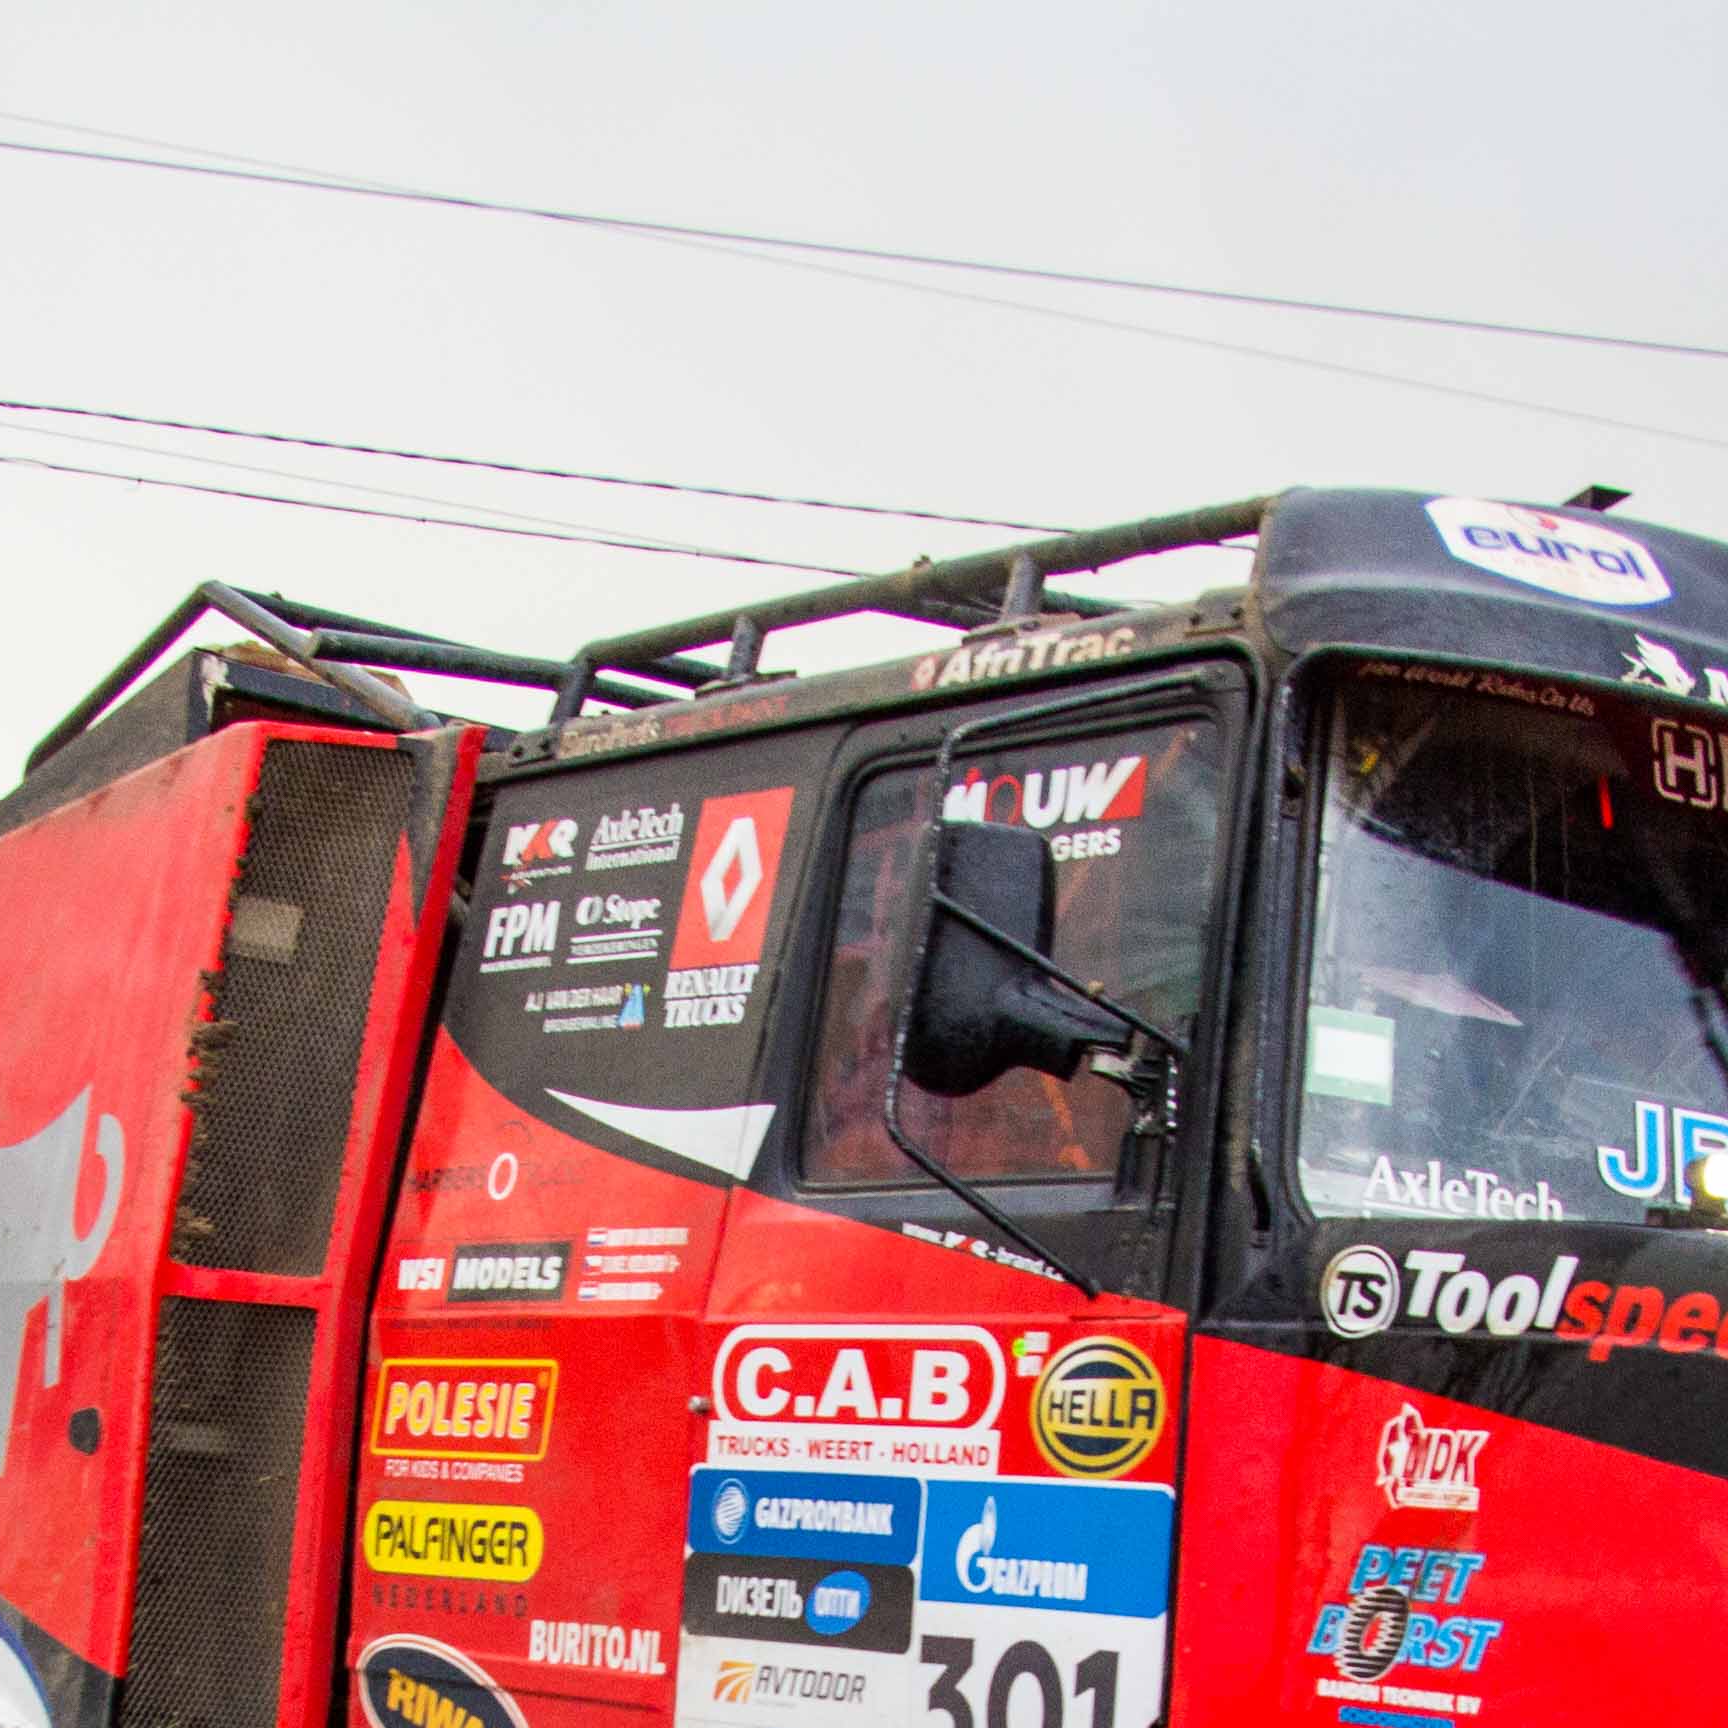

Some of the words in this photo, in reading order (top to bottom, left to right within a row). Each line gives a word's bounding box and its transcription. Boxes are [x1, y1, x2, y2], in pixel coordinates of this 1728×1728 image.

[1461, 526, 1646, 581] eurol
[1050, 827, 1121, 863] GERS
[483, 900, 561, 957] FPM
[664, 964, 760, 999] RENAULT
[664, 995, 747, 1028] TRUCKS
[1362, 1155, 1563, 1222] AxleTech
[398, 1258, 445, 1290] WSI
[453, 1256, 563, 1291] MODELS
[736, 1347, 970, 1421] C.A.B
[385, 1381, 536, 1438] POLESIE
[1048, 1387, 1156, 1431] HELLA
[385, 1459, 415, 1478] FOR
[451, 1461, 523, 1483] COMPANIES
[717, 1435, 790, 1458] TRUCKS
[808, 1438, 873, 1462] WEERT
[892, 1442, 990, 1467] HOLLAND
[754, 1497, 894, 1536] GAZPROMBANK
[375, 1513, 528, 1567] PALFINGER
[991, 1556, 1088, 1601] GAZPROM
[1348, 1543, 1485, 1604] PEET
[373, 1585, 528, 1617] NEDERLAND
[529, 1620, 666, 1675] BURITO.NL
[756, 1665, 865, 1703] AVTODOR
